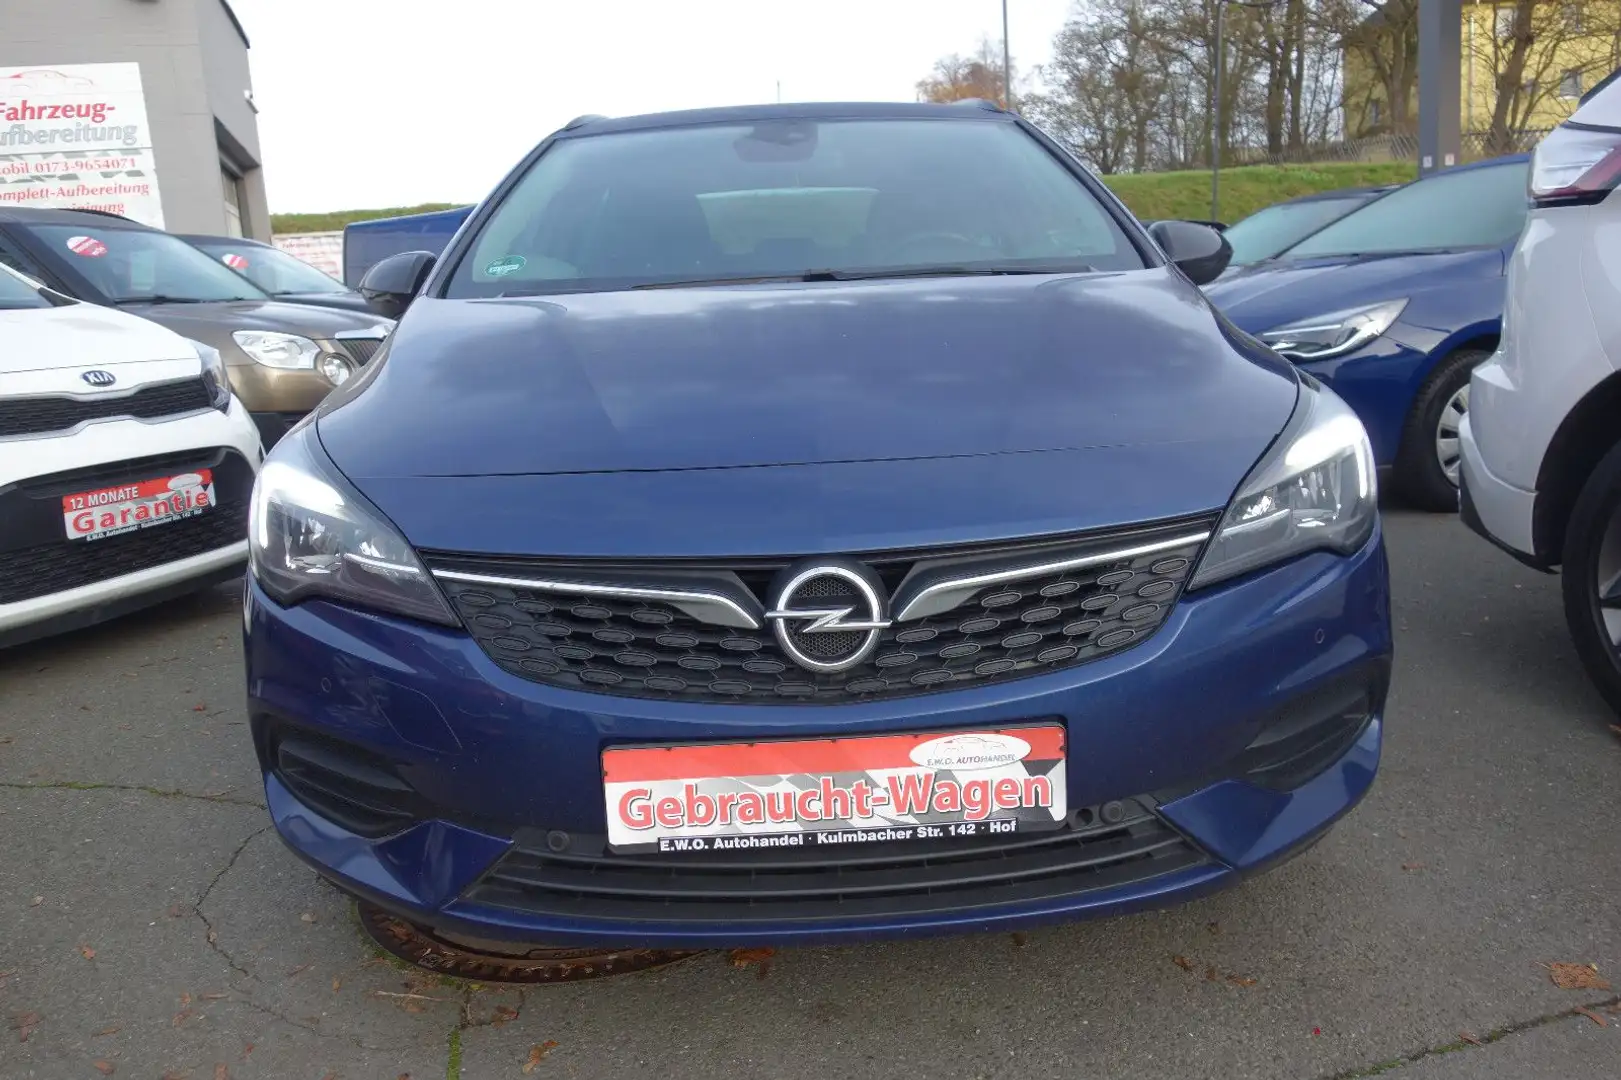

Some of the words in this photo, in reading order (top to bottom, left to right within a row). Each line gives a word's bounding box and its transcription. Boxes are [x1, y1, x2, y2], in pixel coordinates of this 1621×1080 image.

[0, 122, 138, 146] ufbereitung
[0, 162, 29, 176] obil
[35, 158, 136, 174] 0173-9654071
[0, 183, 149, 203] mplett-Aufbereitung
[86, 371, 114, 384] KIA
[70, 497, 84, 510] 12
[88, 486, 139, 507] MONATE
[72, 490, 210, 534] Garantie
[956, 754, 1015, 764] AUTOHANDEL
[617, 772, 1053, 830] Gebraucht-Wagen
[660, 838, 709, 852] E.W.O.
[713, 834, 804, 850] Autohandel
[817, 828, 912, 845] Kulmbacher
[917, 826, 944, 839] Str.
[949, 823, 976, 836] 142
[989, 820, 1017, 833] Hof
